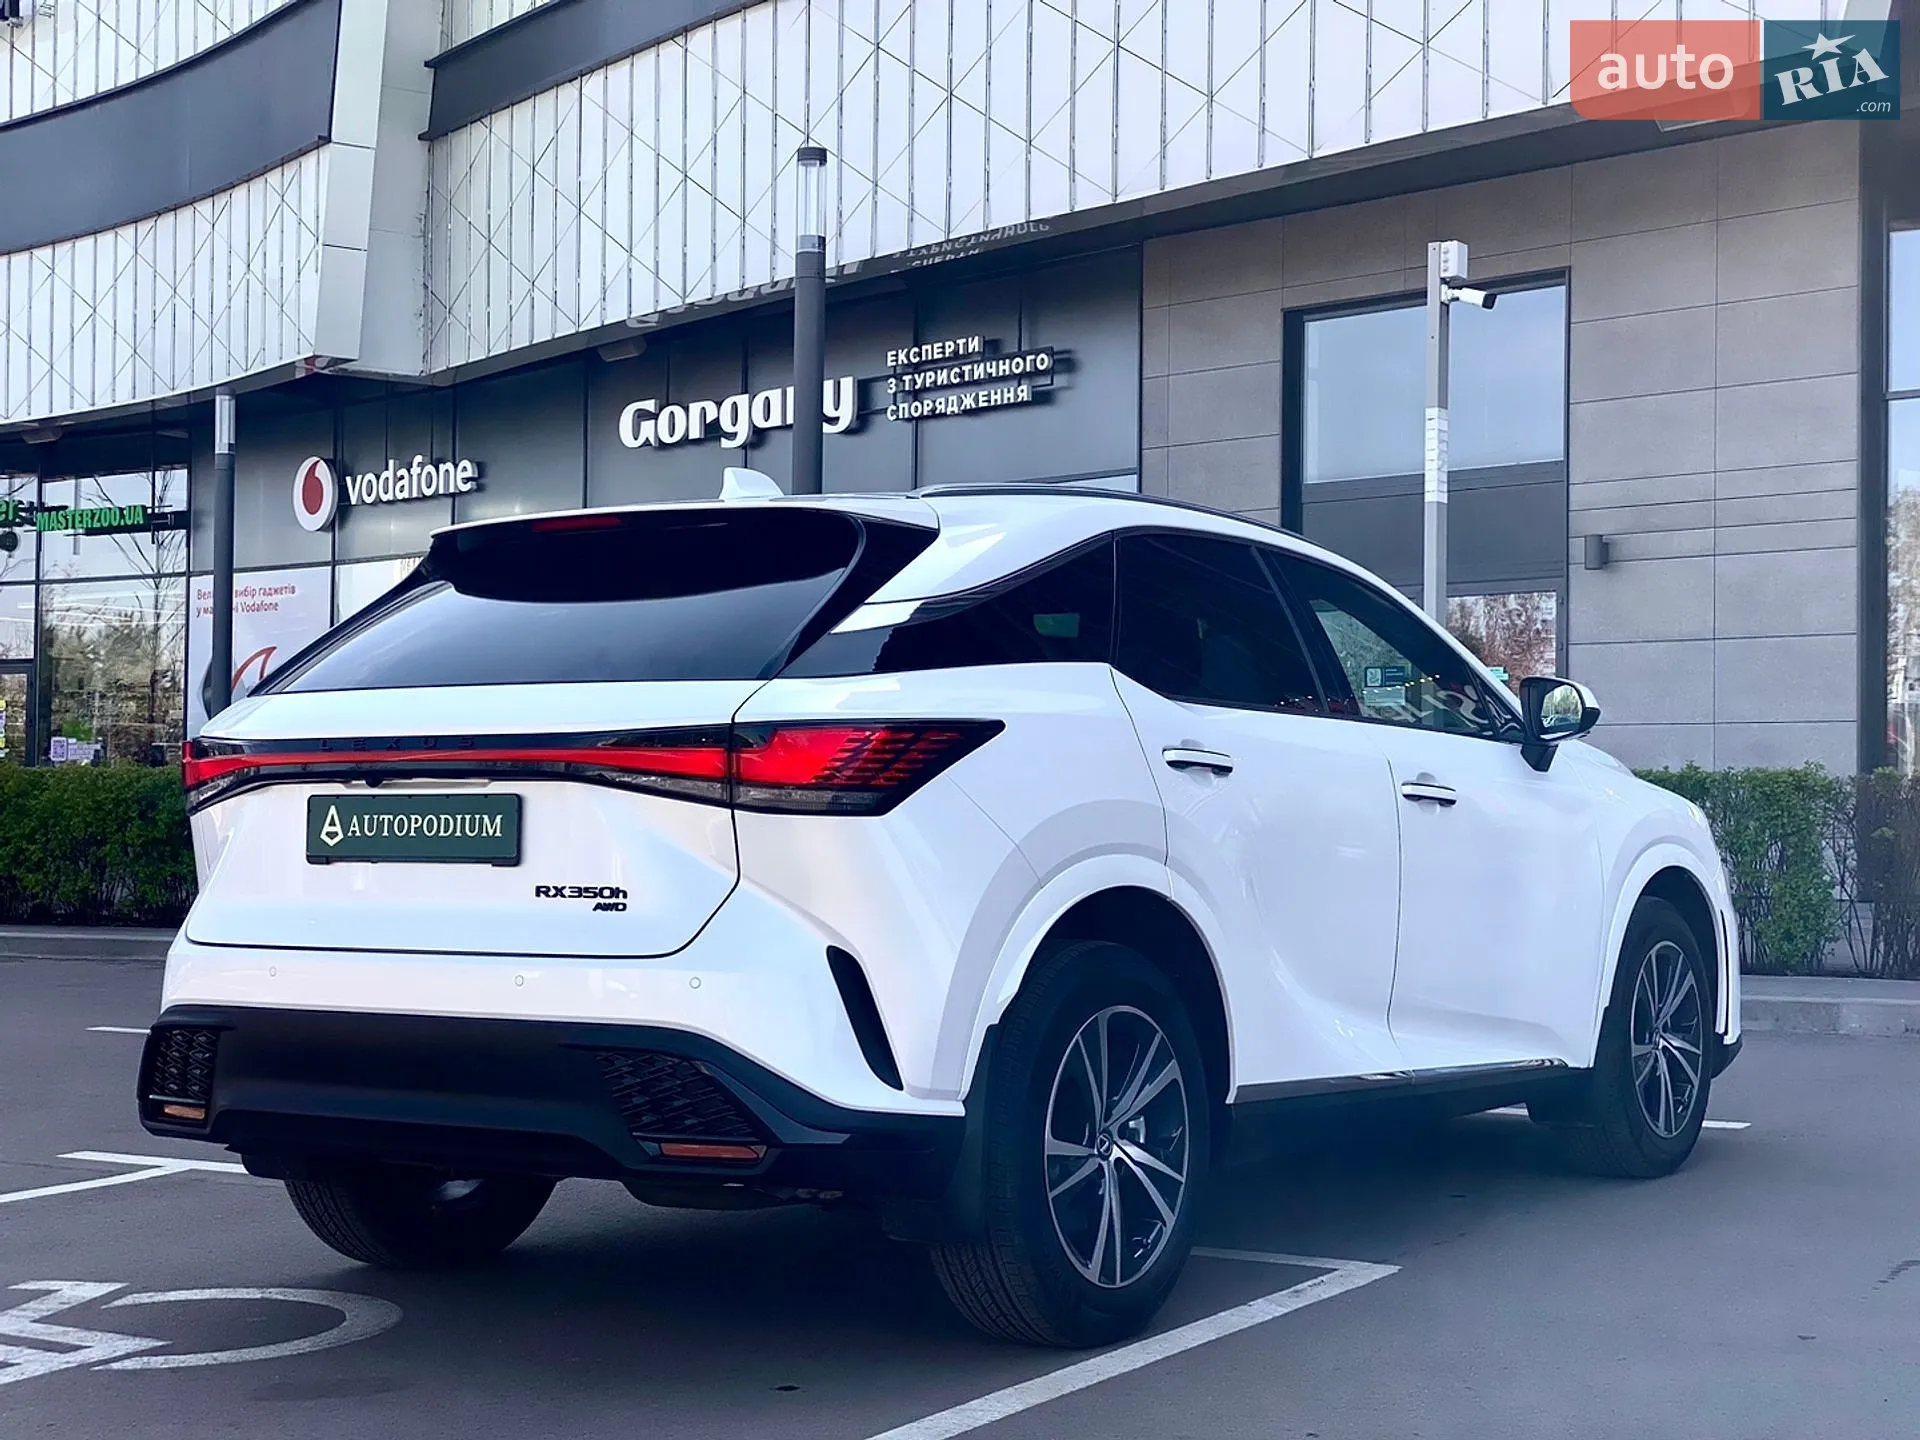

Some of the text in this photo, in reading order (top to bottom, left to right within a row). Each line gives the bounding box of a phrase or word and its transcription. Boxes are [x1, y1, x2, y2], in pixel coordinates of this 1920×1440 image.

[886, 335, 980, 367] ЕКСПЕРТИ
[902, 352, 1050, 392] ТУРИСТИЧНОГО
[886, 384, 1029, 421] СПОРЯДЖЕННЯ
[346, 454, 474, 506] vodafone
[37, 504, 144, 532] MASTERZOO.UA
[258, 583, 296, 598] гаджетів
[240, 600, 279, 613] Vodafone
[319, 736, 476, 752] LEXUS
[347, 813, 503, 838] AUTOPODIUM
[535, 885, 628, 899] RX350h
[592, 902, 627, 912] AWD
